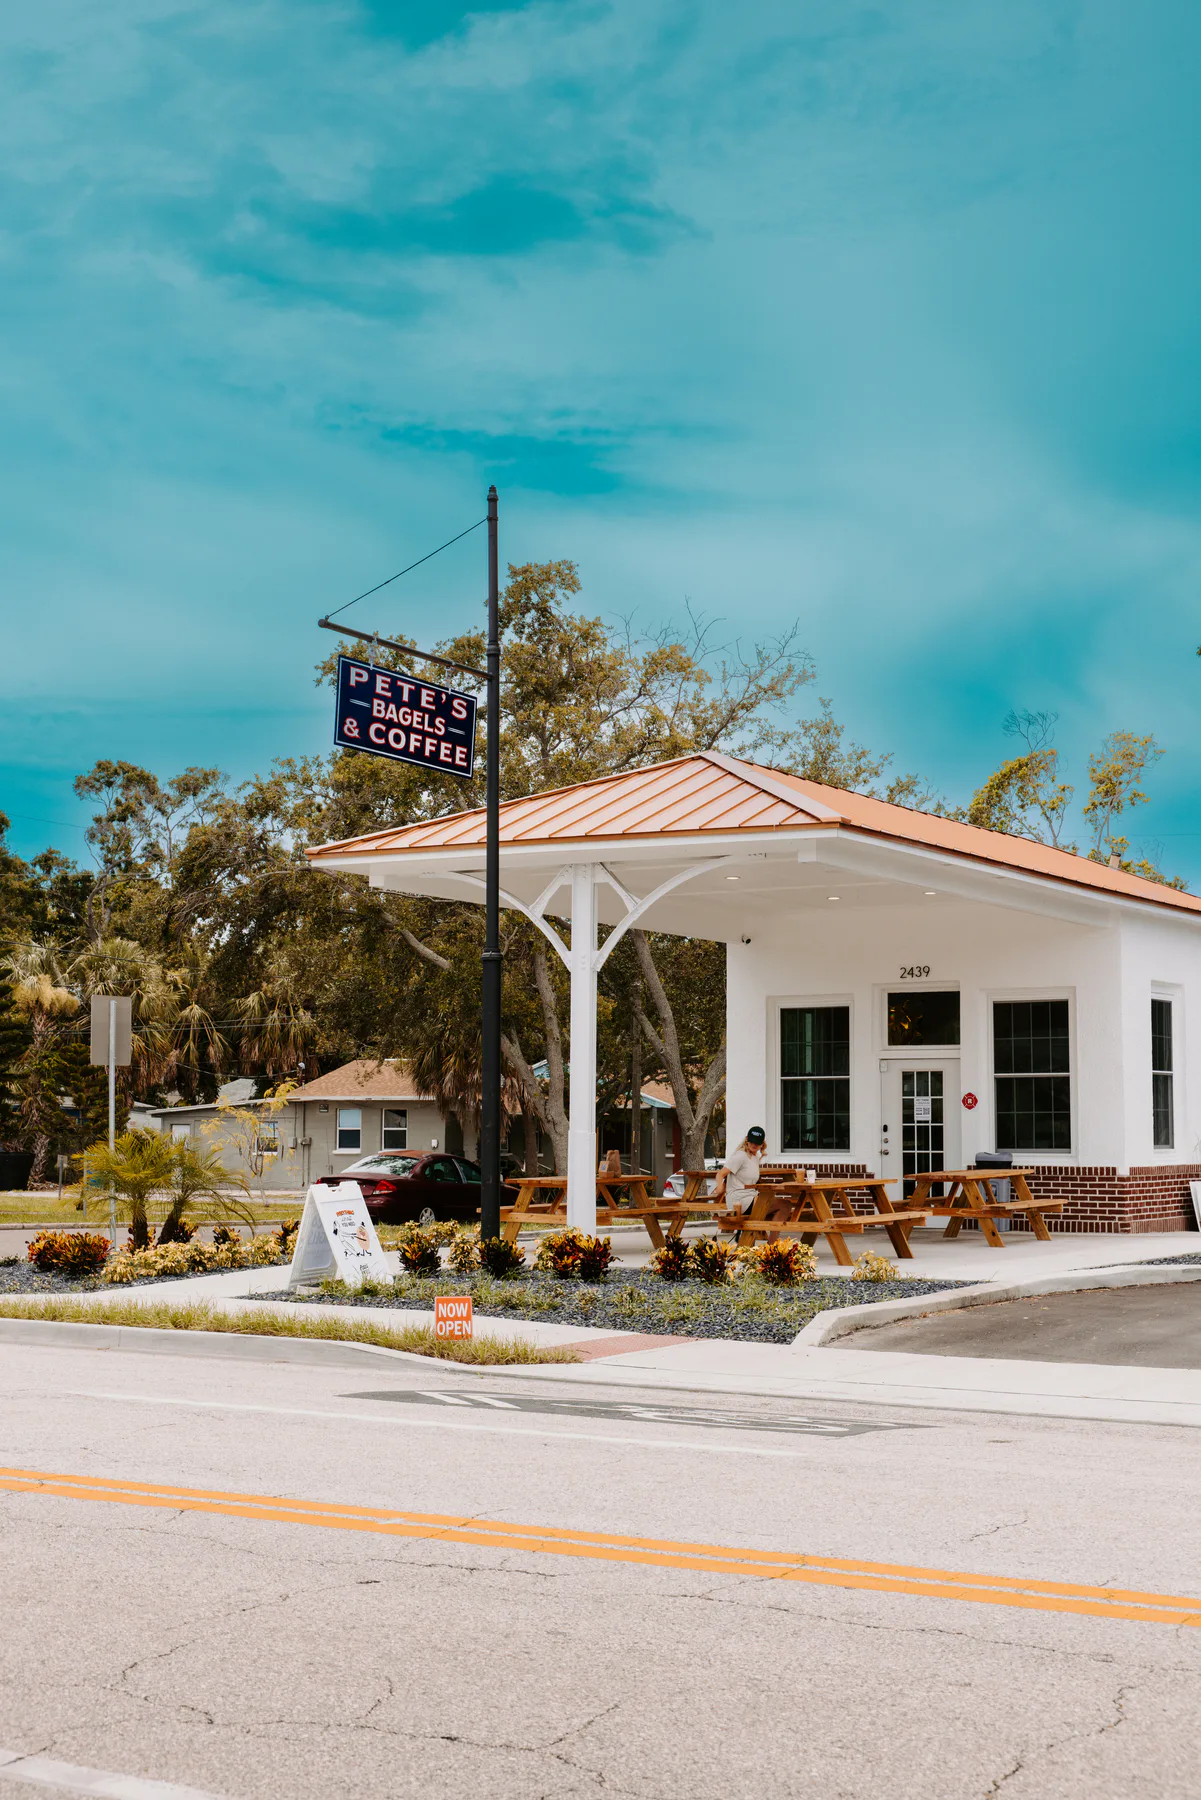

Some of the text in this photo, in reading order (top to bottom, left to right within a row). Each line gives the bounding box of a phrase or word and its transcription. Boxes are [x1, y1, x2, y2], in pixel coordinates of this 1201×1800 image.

[349, 665, 468, 720] PETE'S
[372, 698, 446, 736] BAGELS
[343, 717, 468, 767] & COFFEE
[899, 965, 931, 979] 2439
[438, 1302, 469, 1318] NOW
[437, 1320, 471, 1336] OPEN
